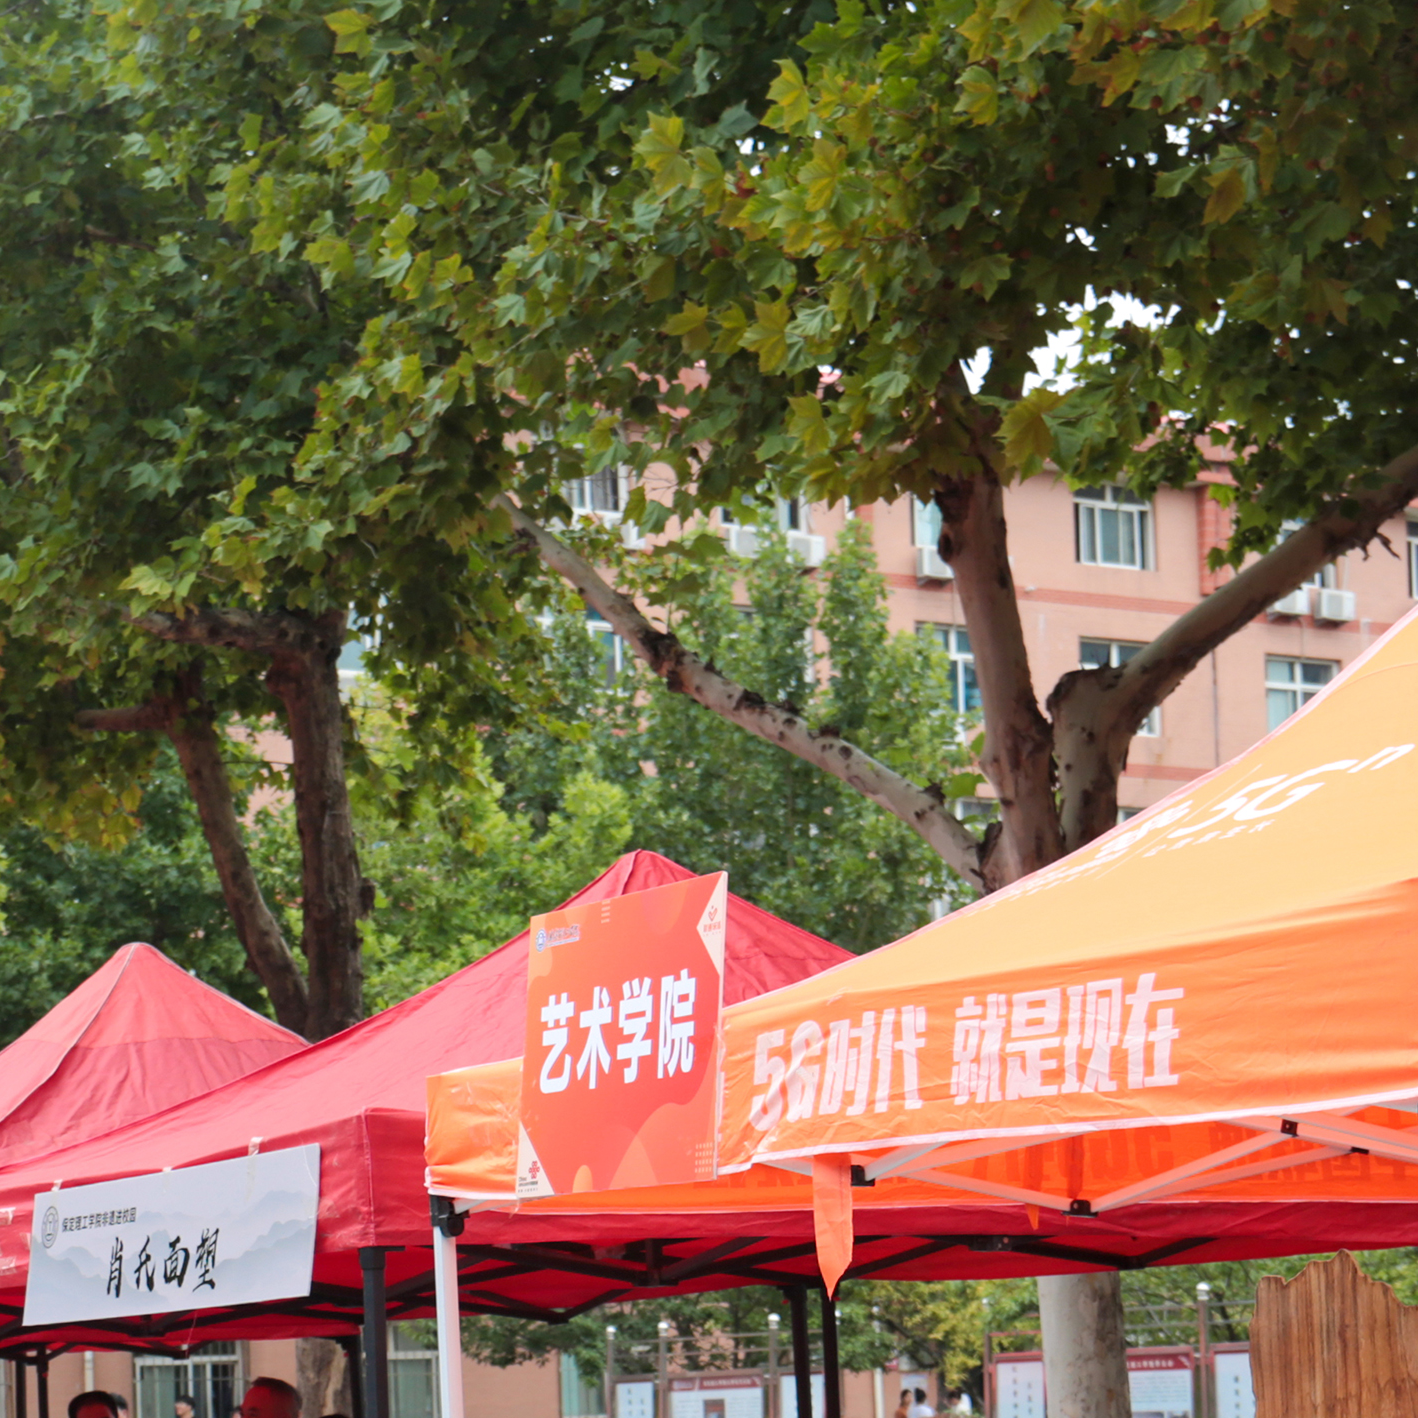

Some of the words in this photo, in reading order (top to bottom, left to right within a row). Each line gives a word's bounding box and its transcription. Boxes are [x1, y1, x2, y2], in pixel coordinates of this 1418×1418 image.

[539, 969, 696, 1094] 艺术学院
[749, 1004, 928, 1132] 5G时代
[950, 971, 1185, 1106] 就是现在
[61, 1207, 137, 1234] 保定理工学院非遗进校园
[106, 1228, 221, 1300] 肖氏面塑
